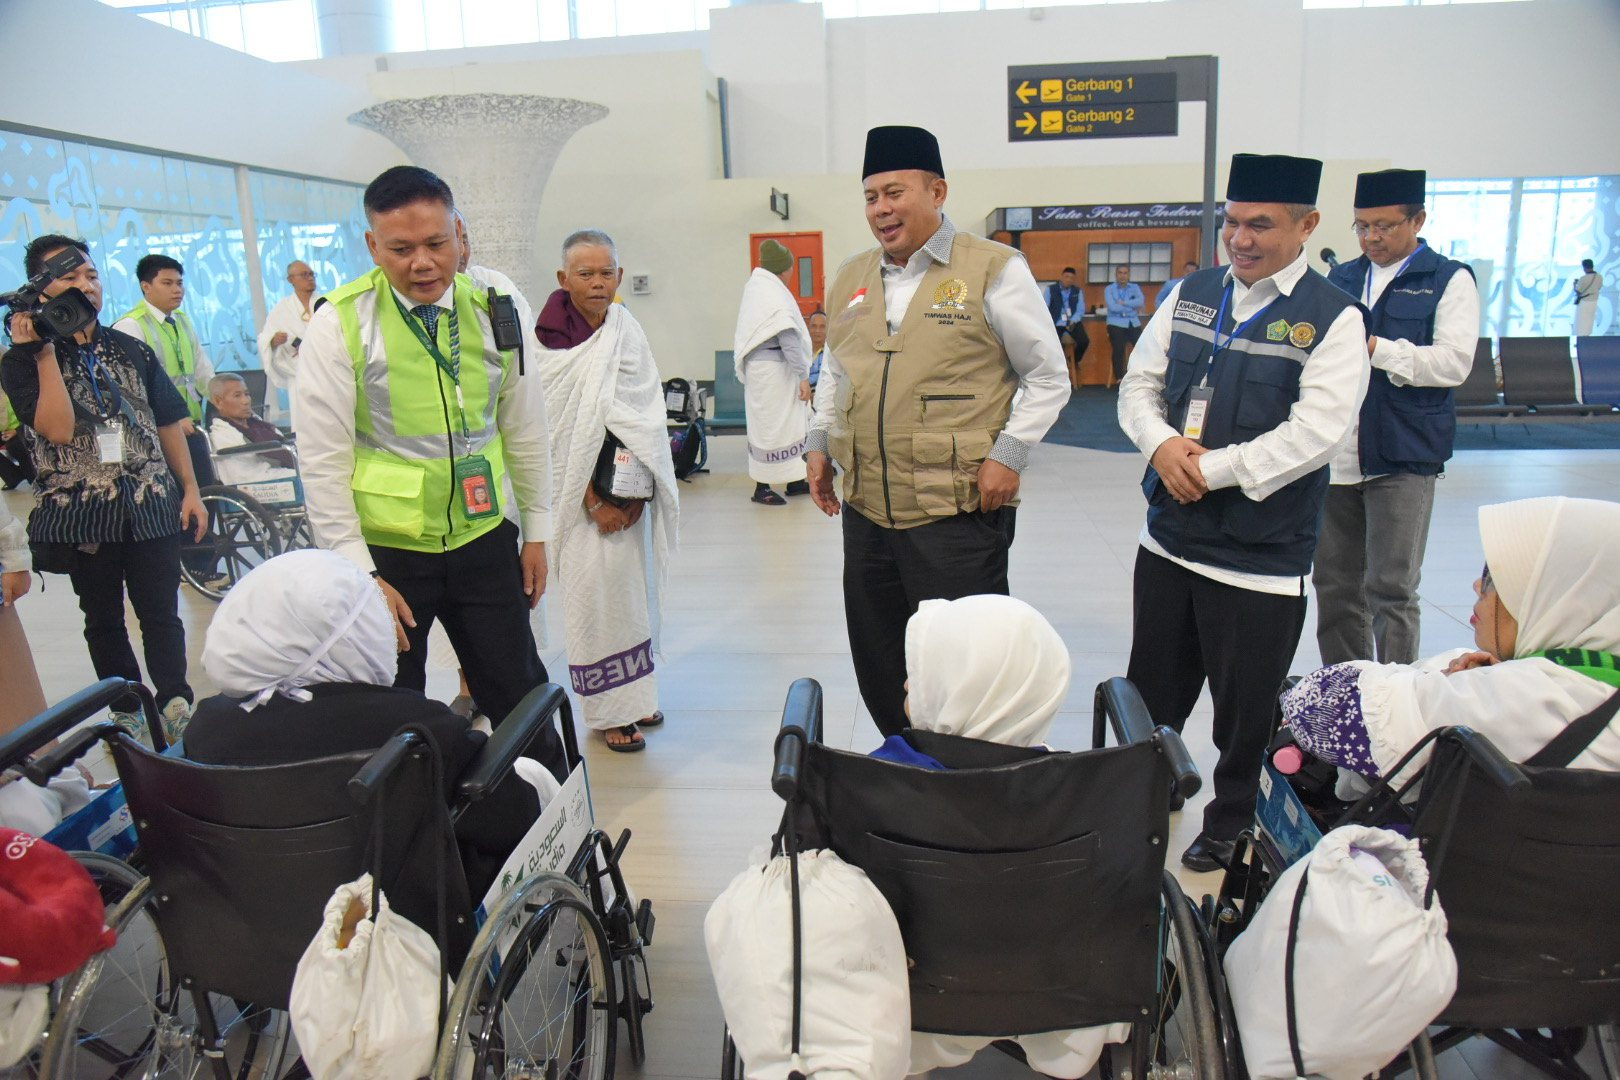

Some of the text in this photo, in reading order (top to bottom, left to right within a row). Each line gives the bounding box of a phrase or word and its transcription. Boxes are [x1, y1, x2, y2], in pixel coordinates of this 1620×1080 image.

[1066, 77, 1133, 93] Gerbang 1
[1066, 93, 1092, 102] Gate 1
[1066, 107, 1135, 124] Gerbang 2
[1066, 123, 1093, 133] Gate 2
[1086, 206, 1141, 218] Rasa
[1113, 219, 1135, 227] food
[1137, 218, 1145, 227] &
[1147, 219, 1191, 227] beverage
[1179, 302, 1214, 317] KHAIRUNAS
[528, 806, 567, 873] السعودية
